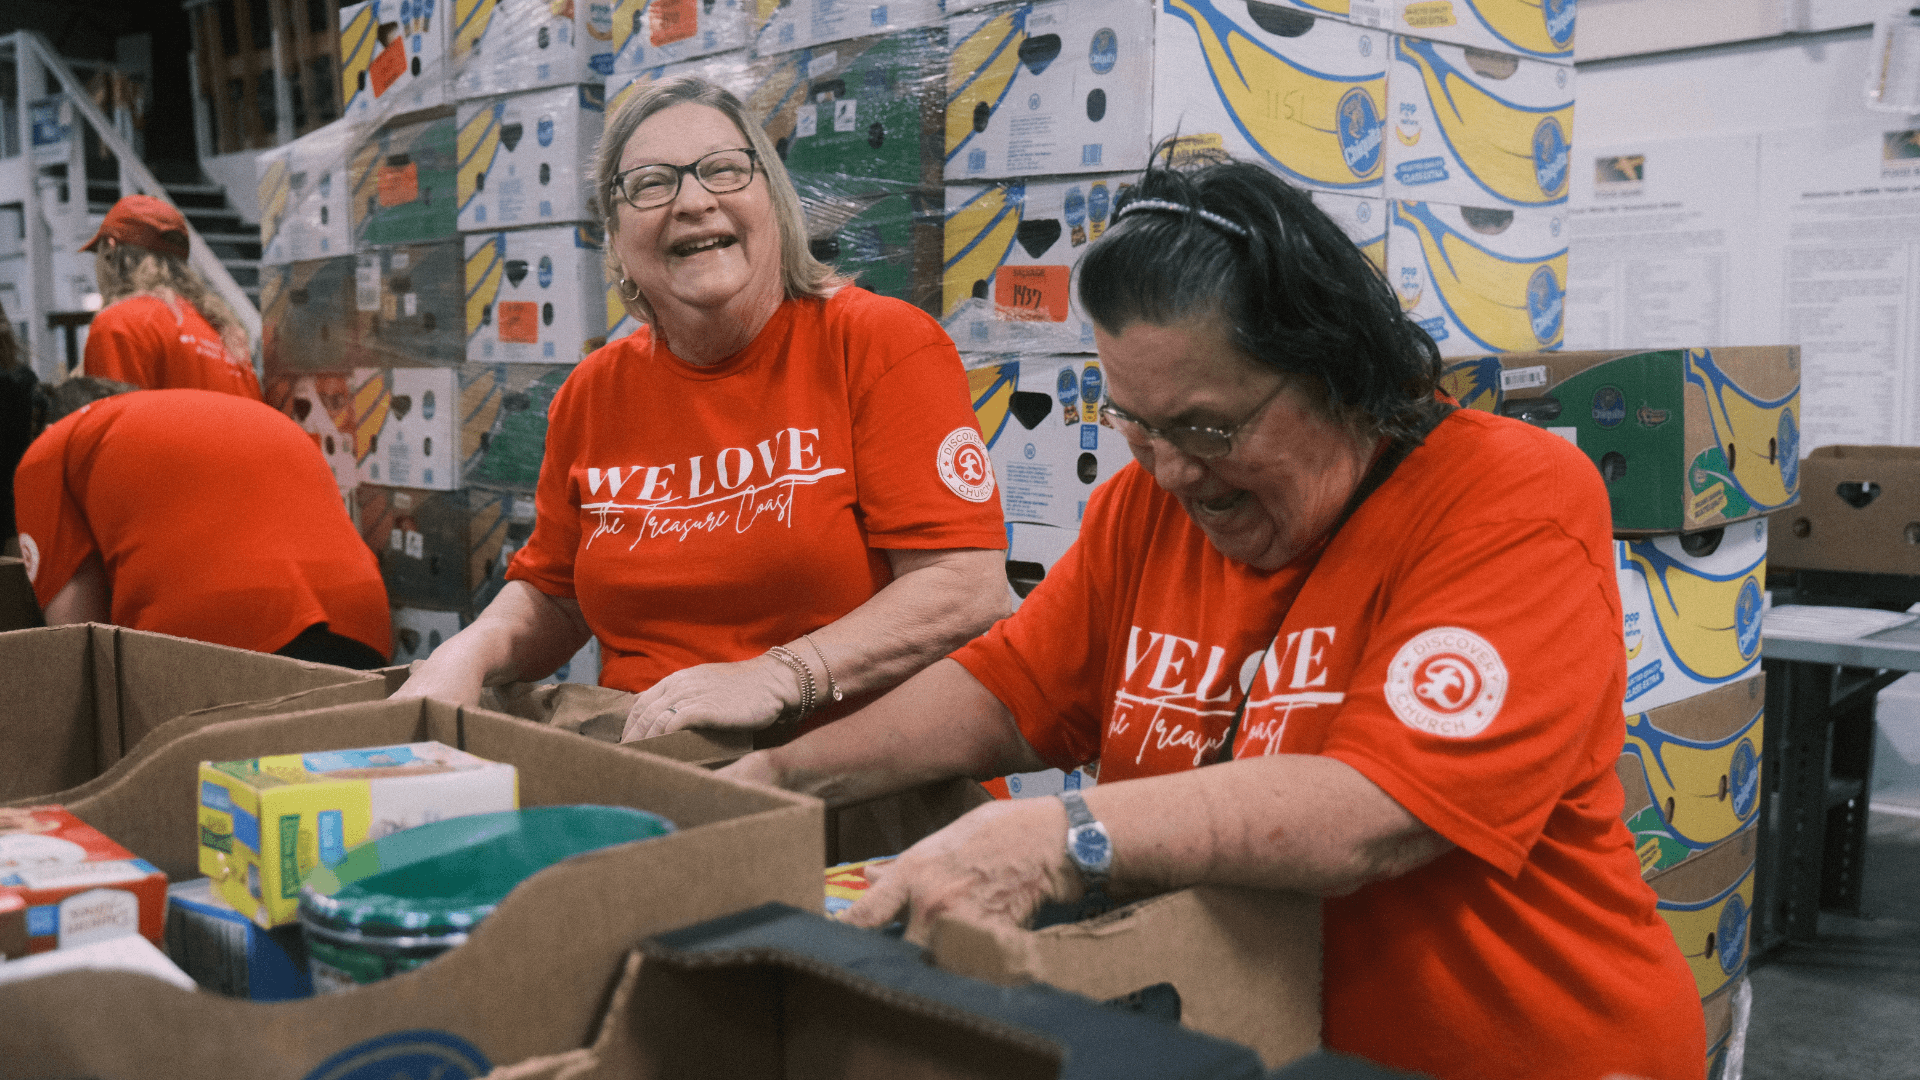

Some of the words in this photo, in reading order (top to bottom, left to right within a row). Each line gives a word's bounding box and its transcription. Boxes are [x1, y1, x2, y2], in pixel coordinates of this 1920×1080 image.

[1012, 284, 1042, 309] 1437
[944, 432, 985, 455] DISCOVERY
[588, 464, 675, 501] WE
[689, 428, 821, 500] LOVE
[959, 482, 991, 497] CHURCH
[586, 500, 625, 549] The
[629, 496, 729, 551] Treasure
[736, 480, 818, 534] Coast
[1413, 635, 1498, 681] DISCOVERY
[1397, 694, 1467, 732] CHURCH
